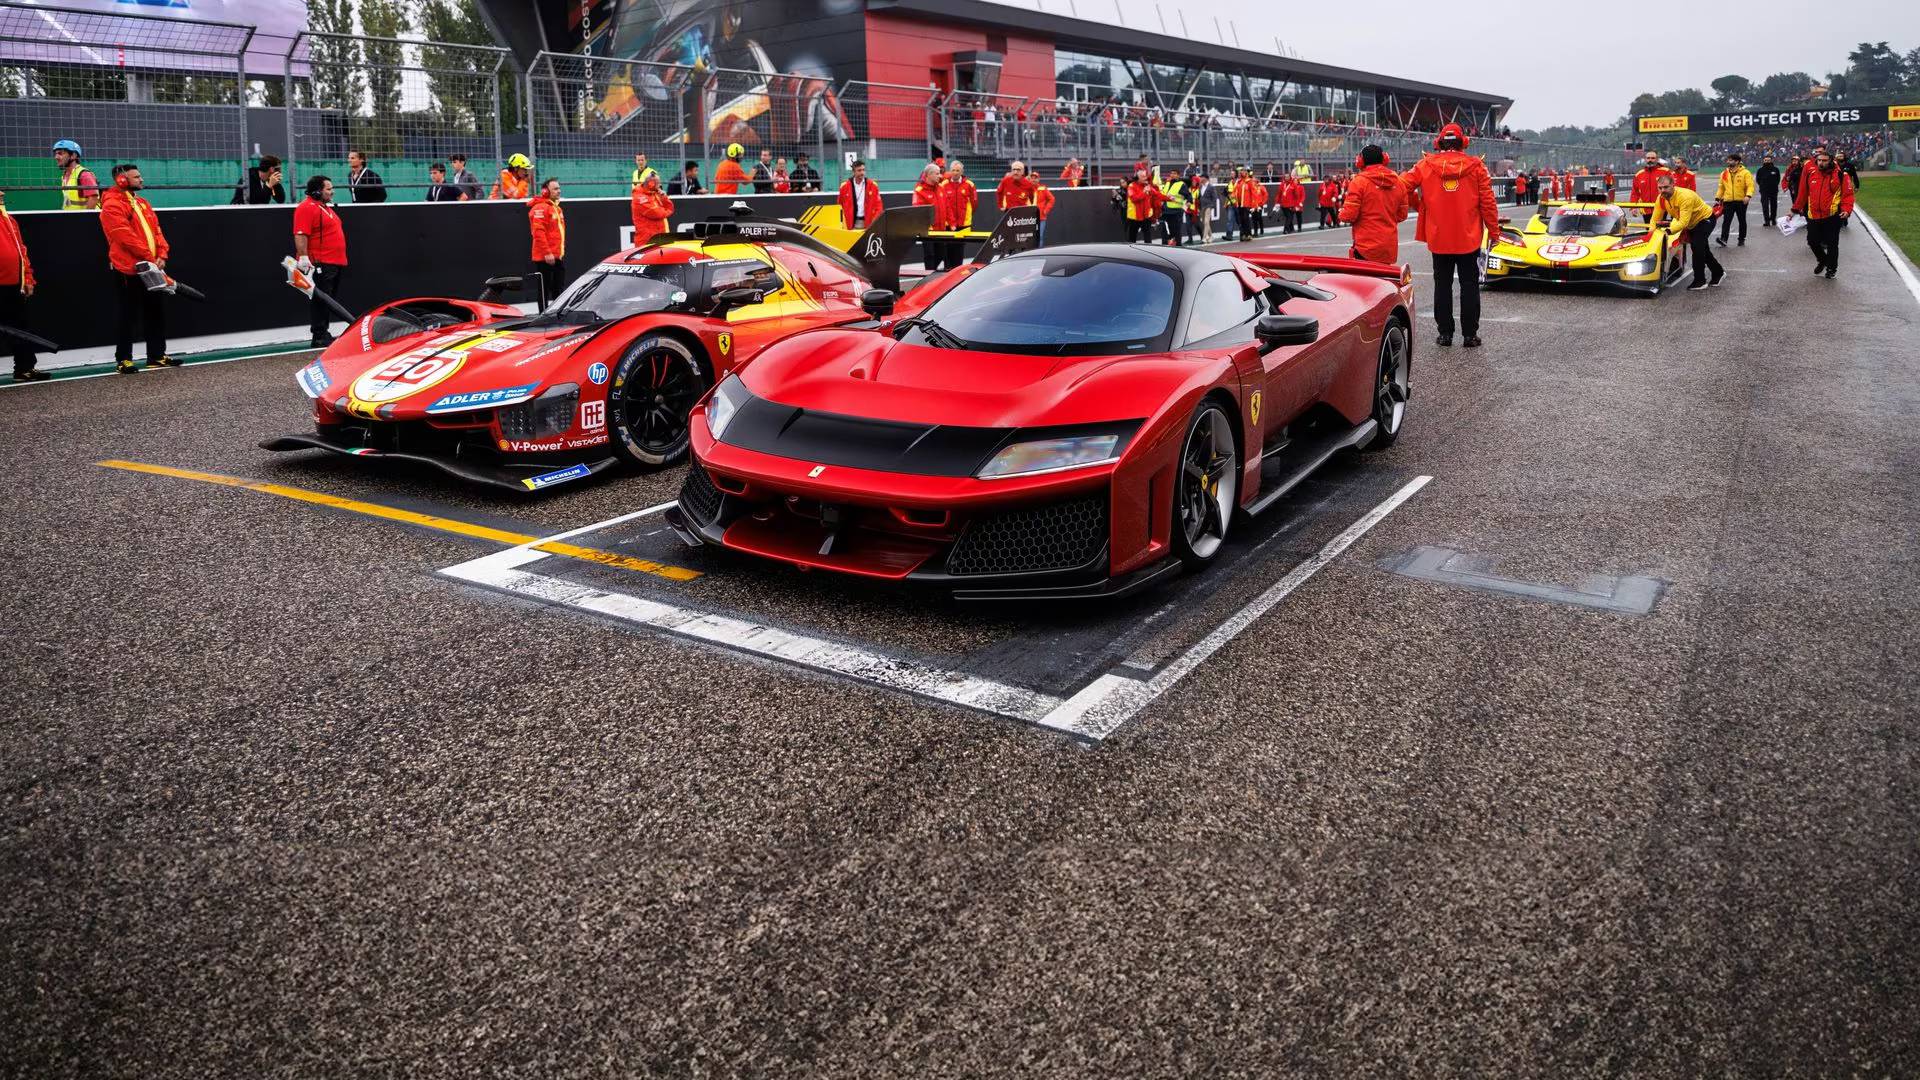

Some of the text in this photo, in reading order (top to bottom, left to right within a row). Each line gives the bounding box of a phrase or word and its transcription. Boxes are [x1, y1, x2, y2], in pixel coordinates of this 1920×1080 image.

[1643, 119, 1684, 129] PIRELLI
[1713, 109, 1860, 128] HIGH-TECH TYRES
[1013, 216, 1037, 227] Santander
[740, 227, 762, 236] ADLER
[592, 263, 650, 274] Ferrari
[623, 338, 658, 372] MICHELIN
[379, 356, 444, 380] 50
[435, 392, 491, 406] ADLER
[511, 440, 562, 452] V-Power
[544, 468, 581, 482] MICHELIN
